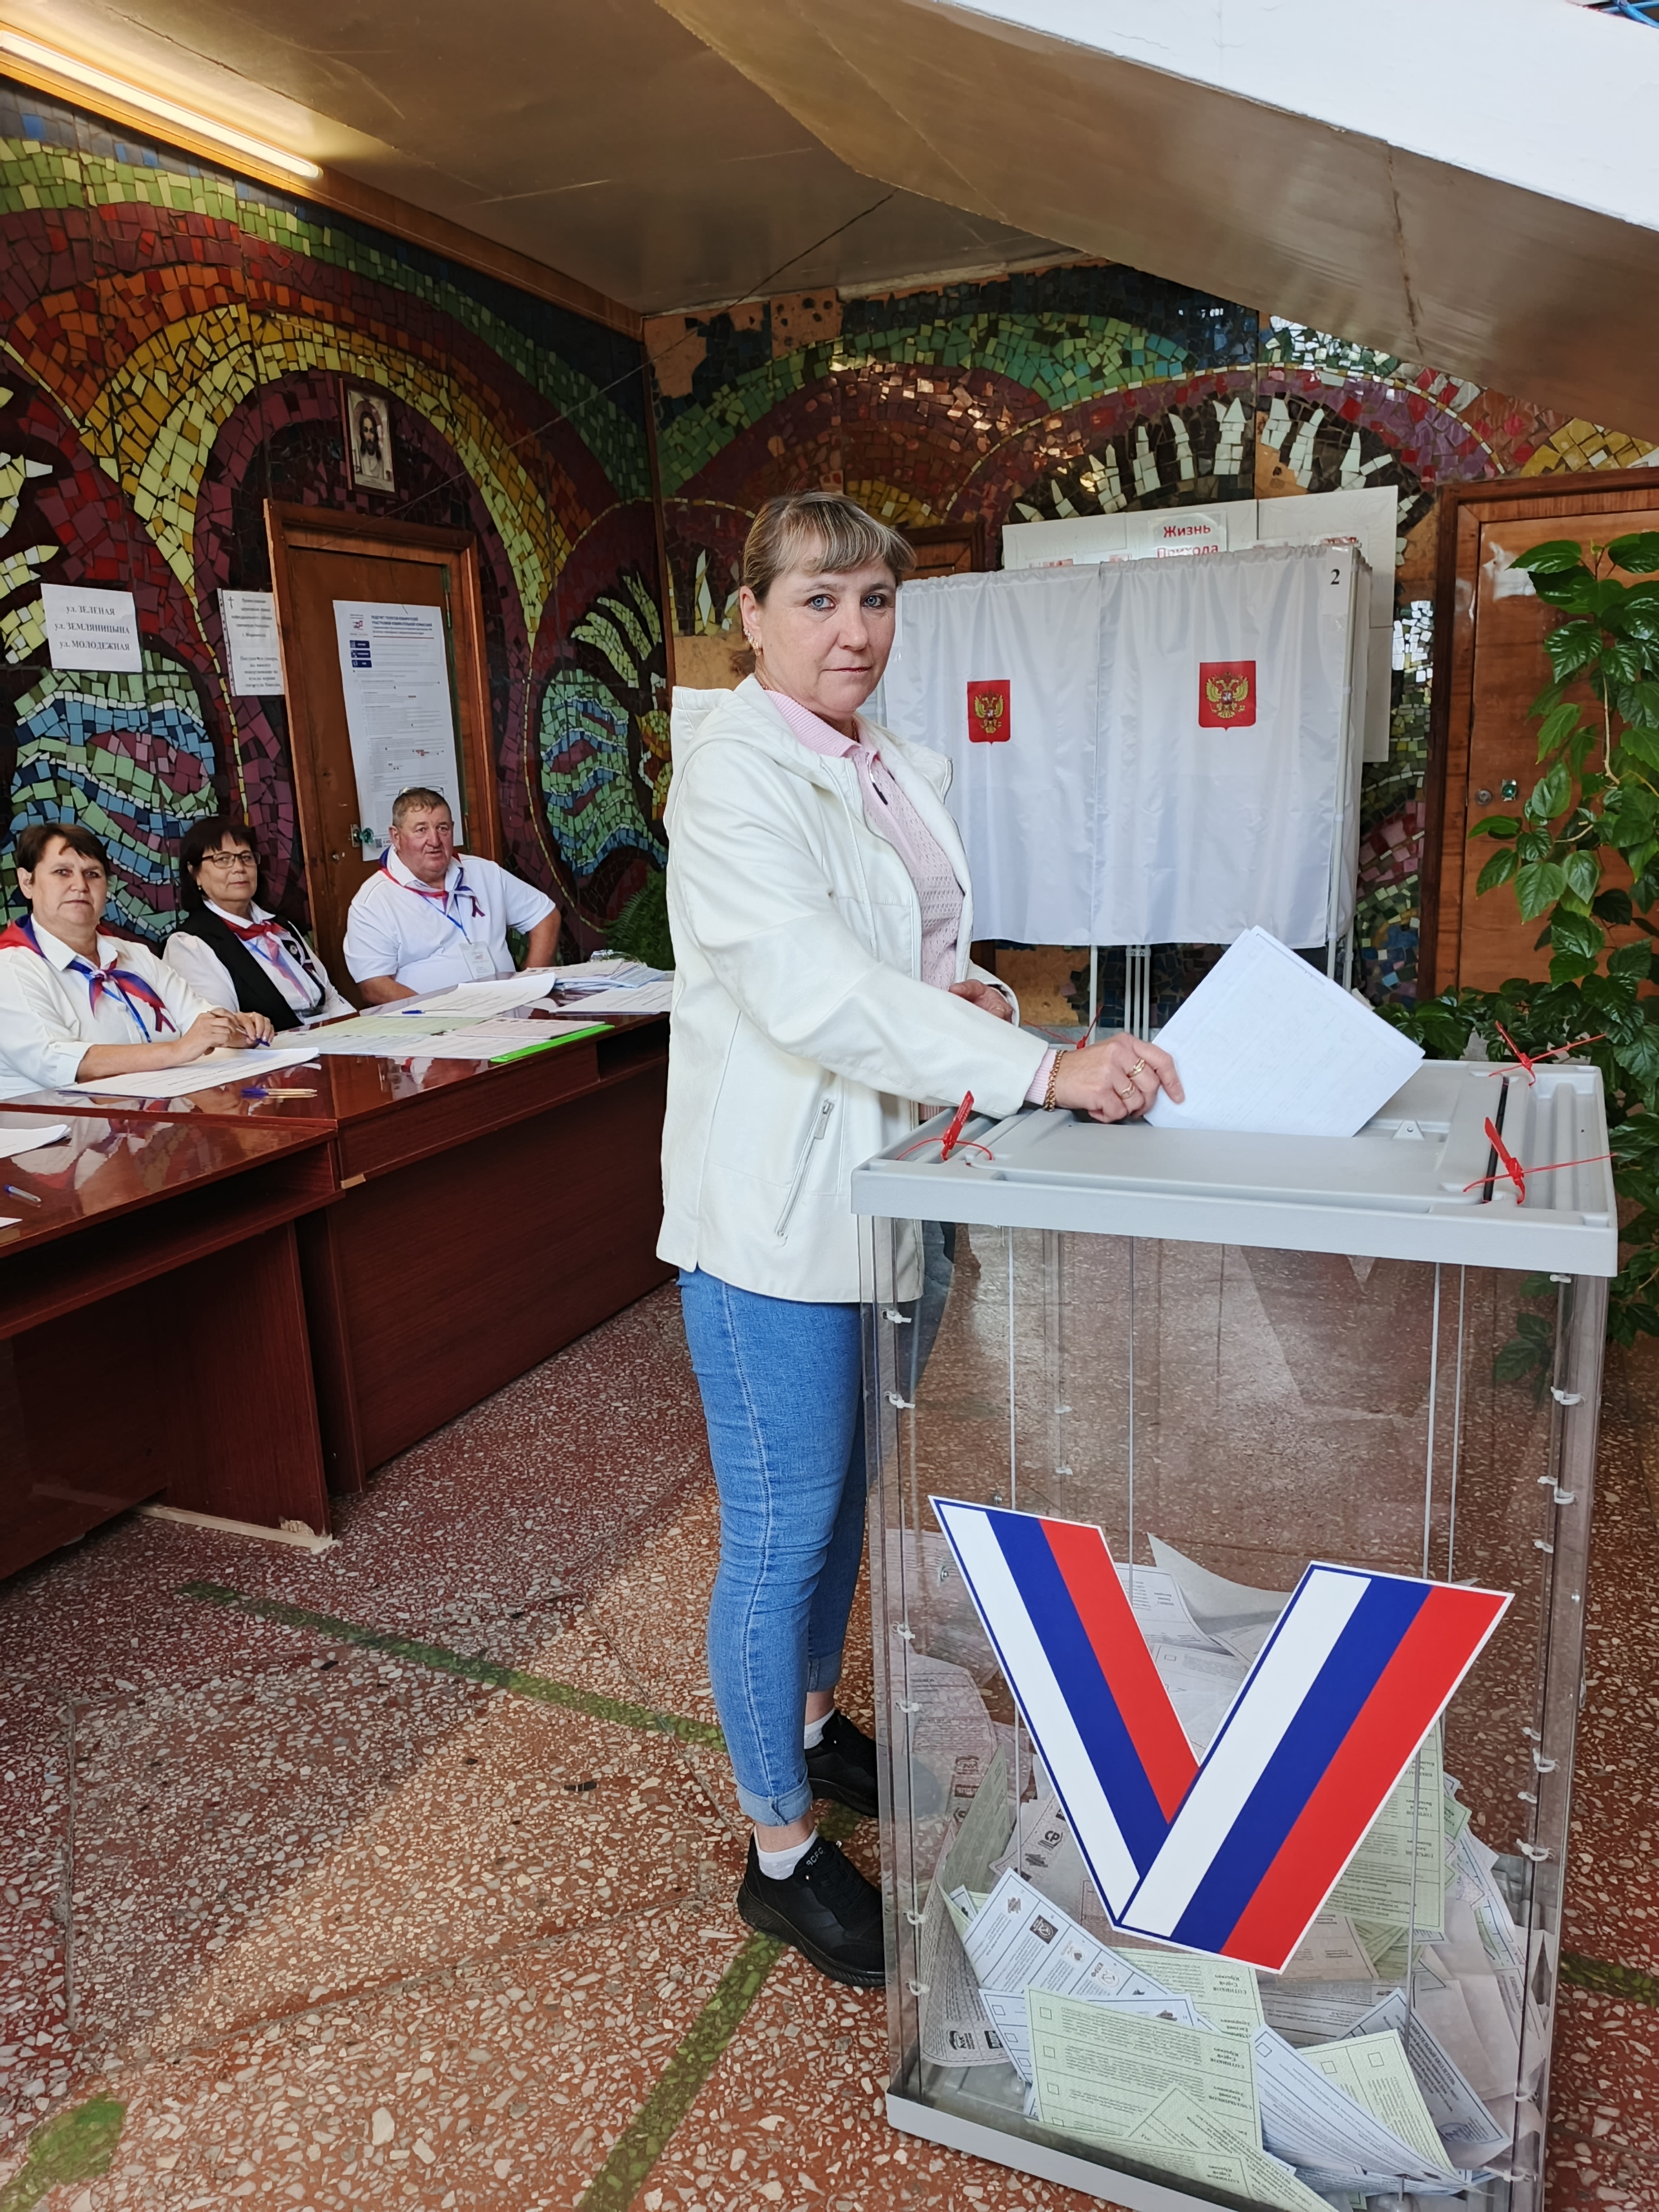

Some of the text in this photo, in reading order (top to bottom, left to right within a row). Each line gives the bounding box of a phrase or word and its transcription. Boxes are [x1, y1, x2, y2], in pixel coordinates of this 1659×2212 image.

[1163, 525, 1211, 538] Жизнь
[1331, 569, 1340, 585] 2
[78, 605, 115, 615] ЗЕЛЕНАЯ
[66, 622, 130, 634] ЗЕМЛЯНИЦЫНА
[72, 640, 130, 651] МОЛОДЕЖНАЯ
